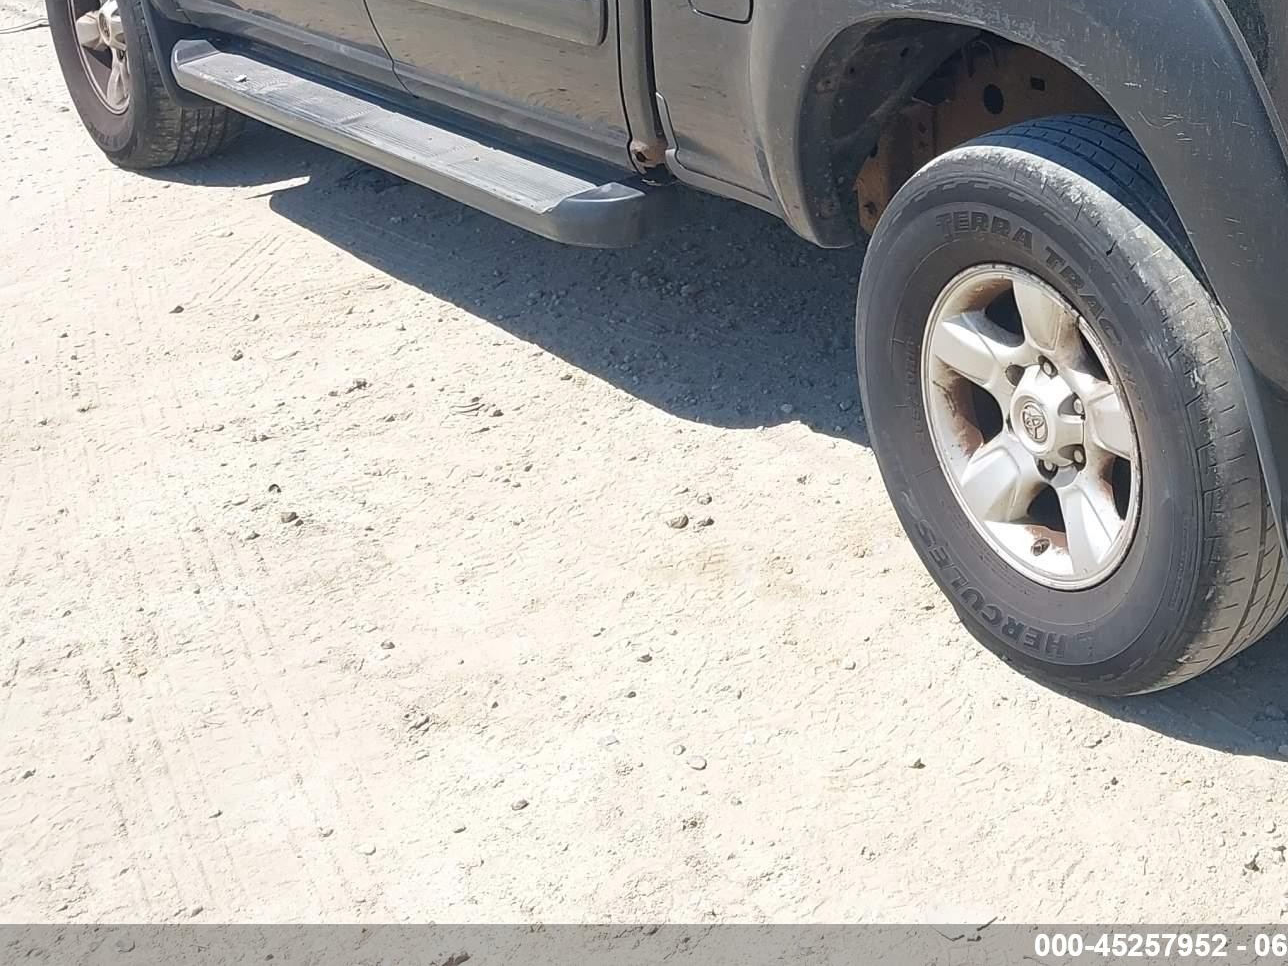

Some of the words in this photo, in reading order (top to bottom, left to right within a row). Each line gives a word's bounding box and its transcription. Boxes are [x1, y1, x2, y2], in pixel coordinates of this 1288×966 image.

[936, 211, 1033, 250] TERRA
[1044, 246, 1122, 346] TRAC
[915, 519, 1065, 659] HERCULES
